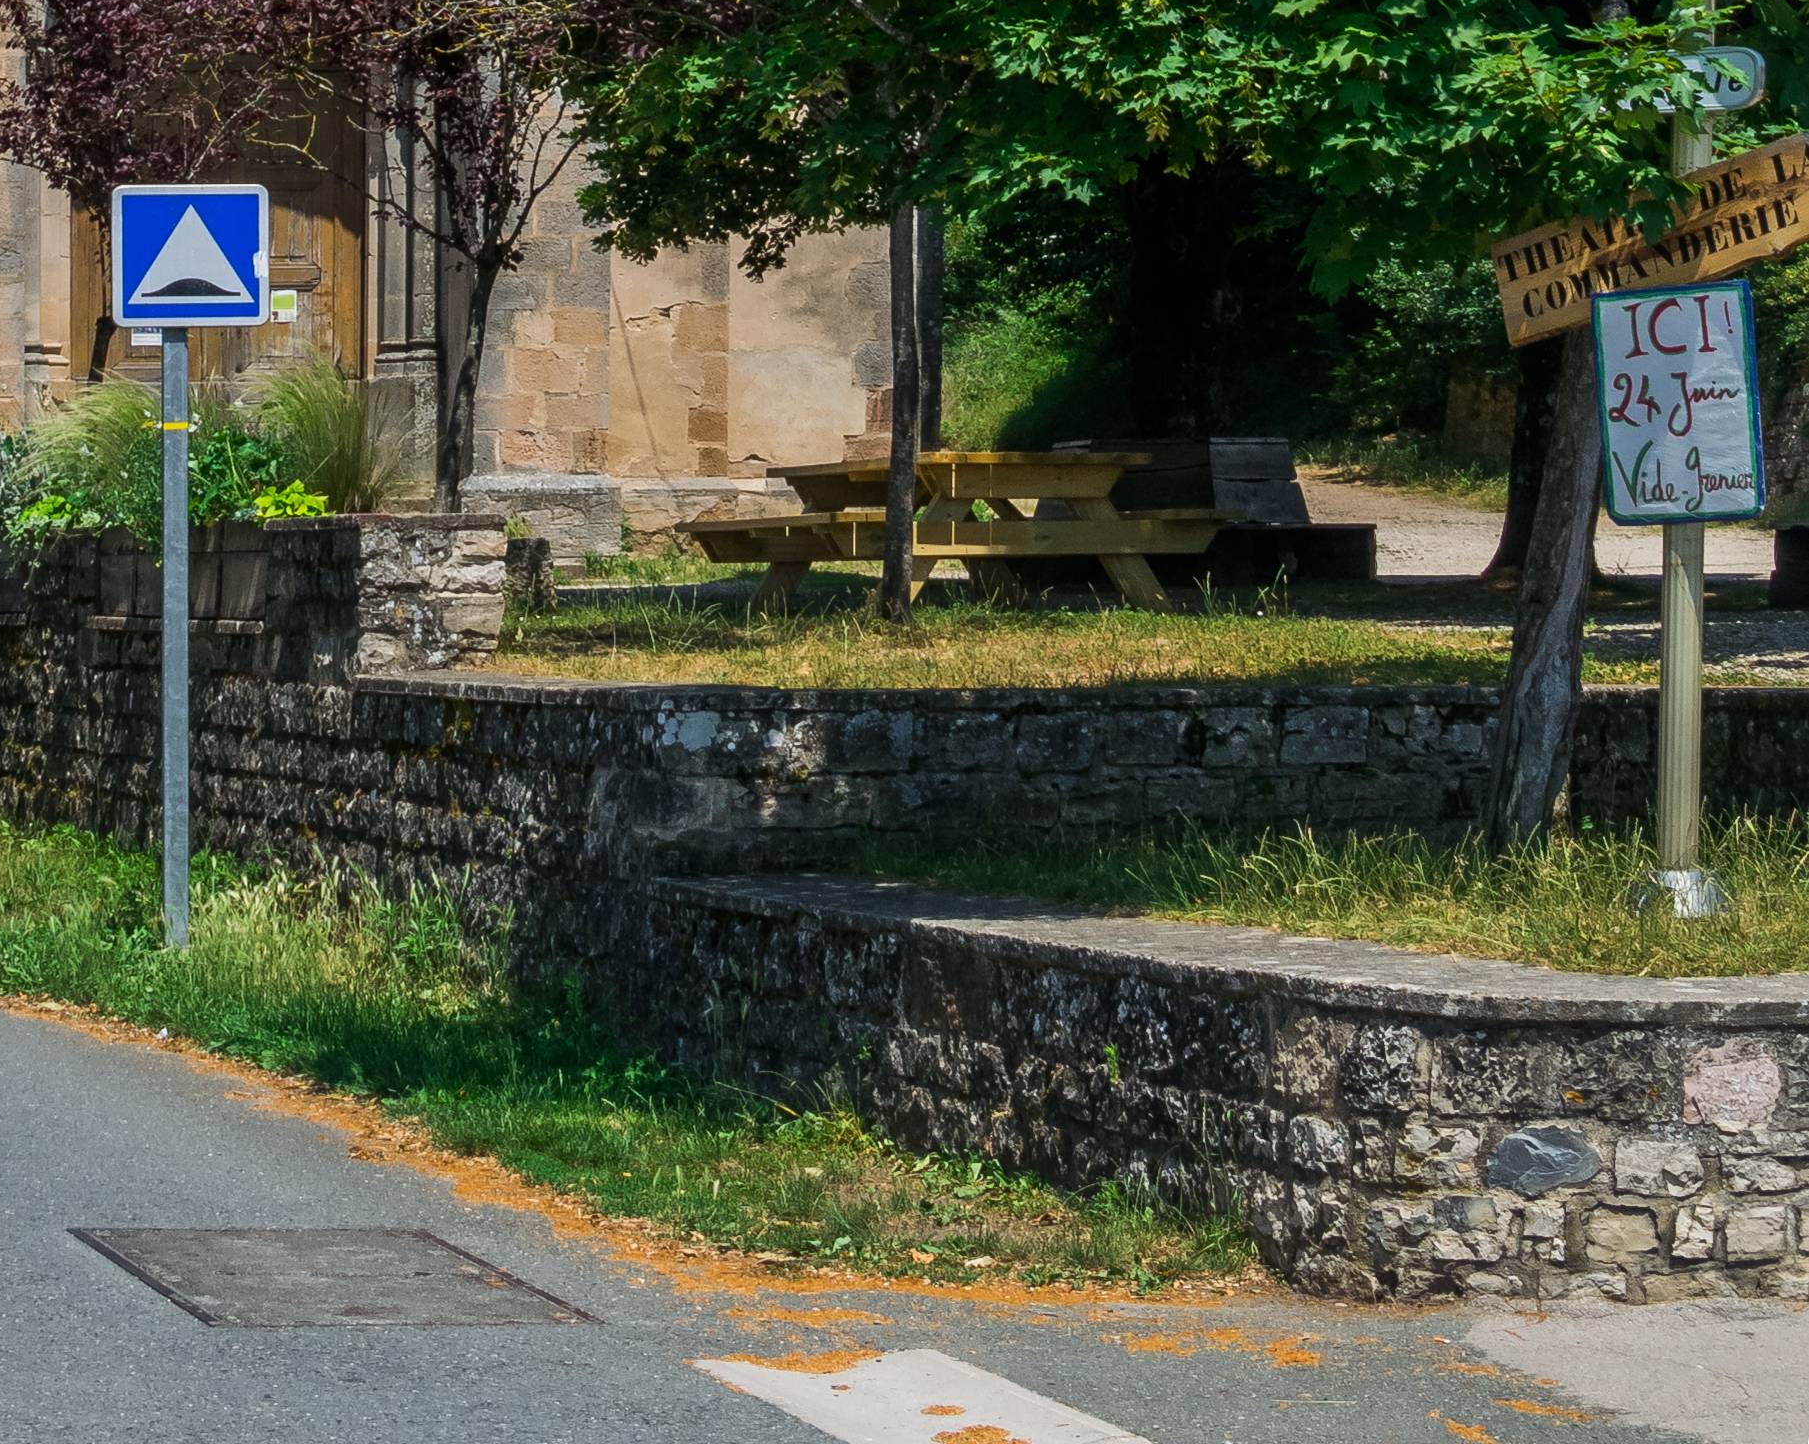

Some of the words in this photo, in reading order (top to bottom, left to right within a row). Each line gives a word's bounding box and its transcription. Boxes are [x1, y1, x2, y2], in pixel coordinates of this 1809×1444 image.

[1698, 167, 1747, 212] DE
[1522, 194, 1800, 319] COMMANDERIE
[1607, 371, 1662, 427] 24
[1666, 370, 1741, 437] Juin
